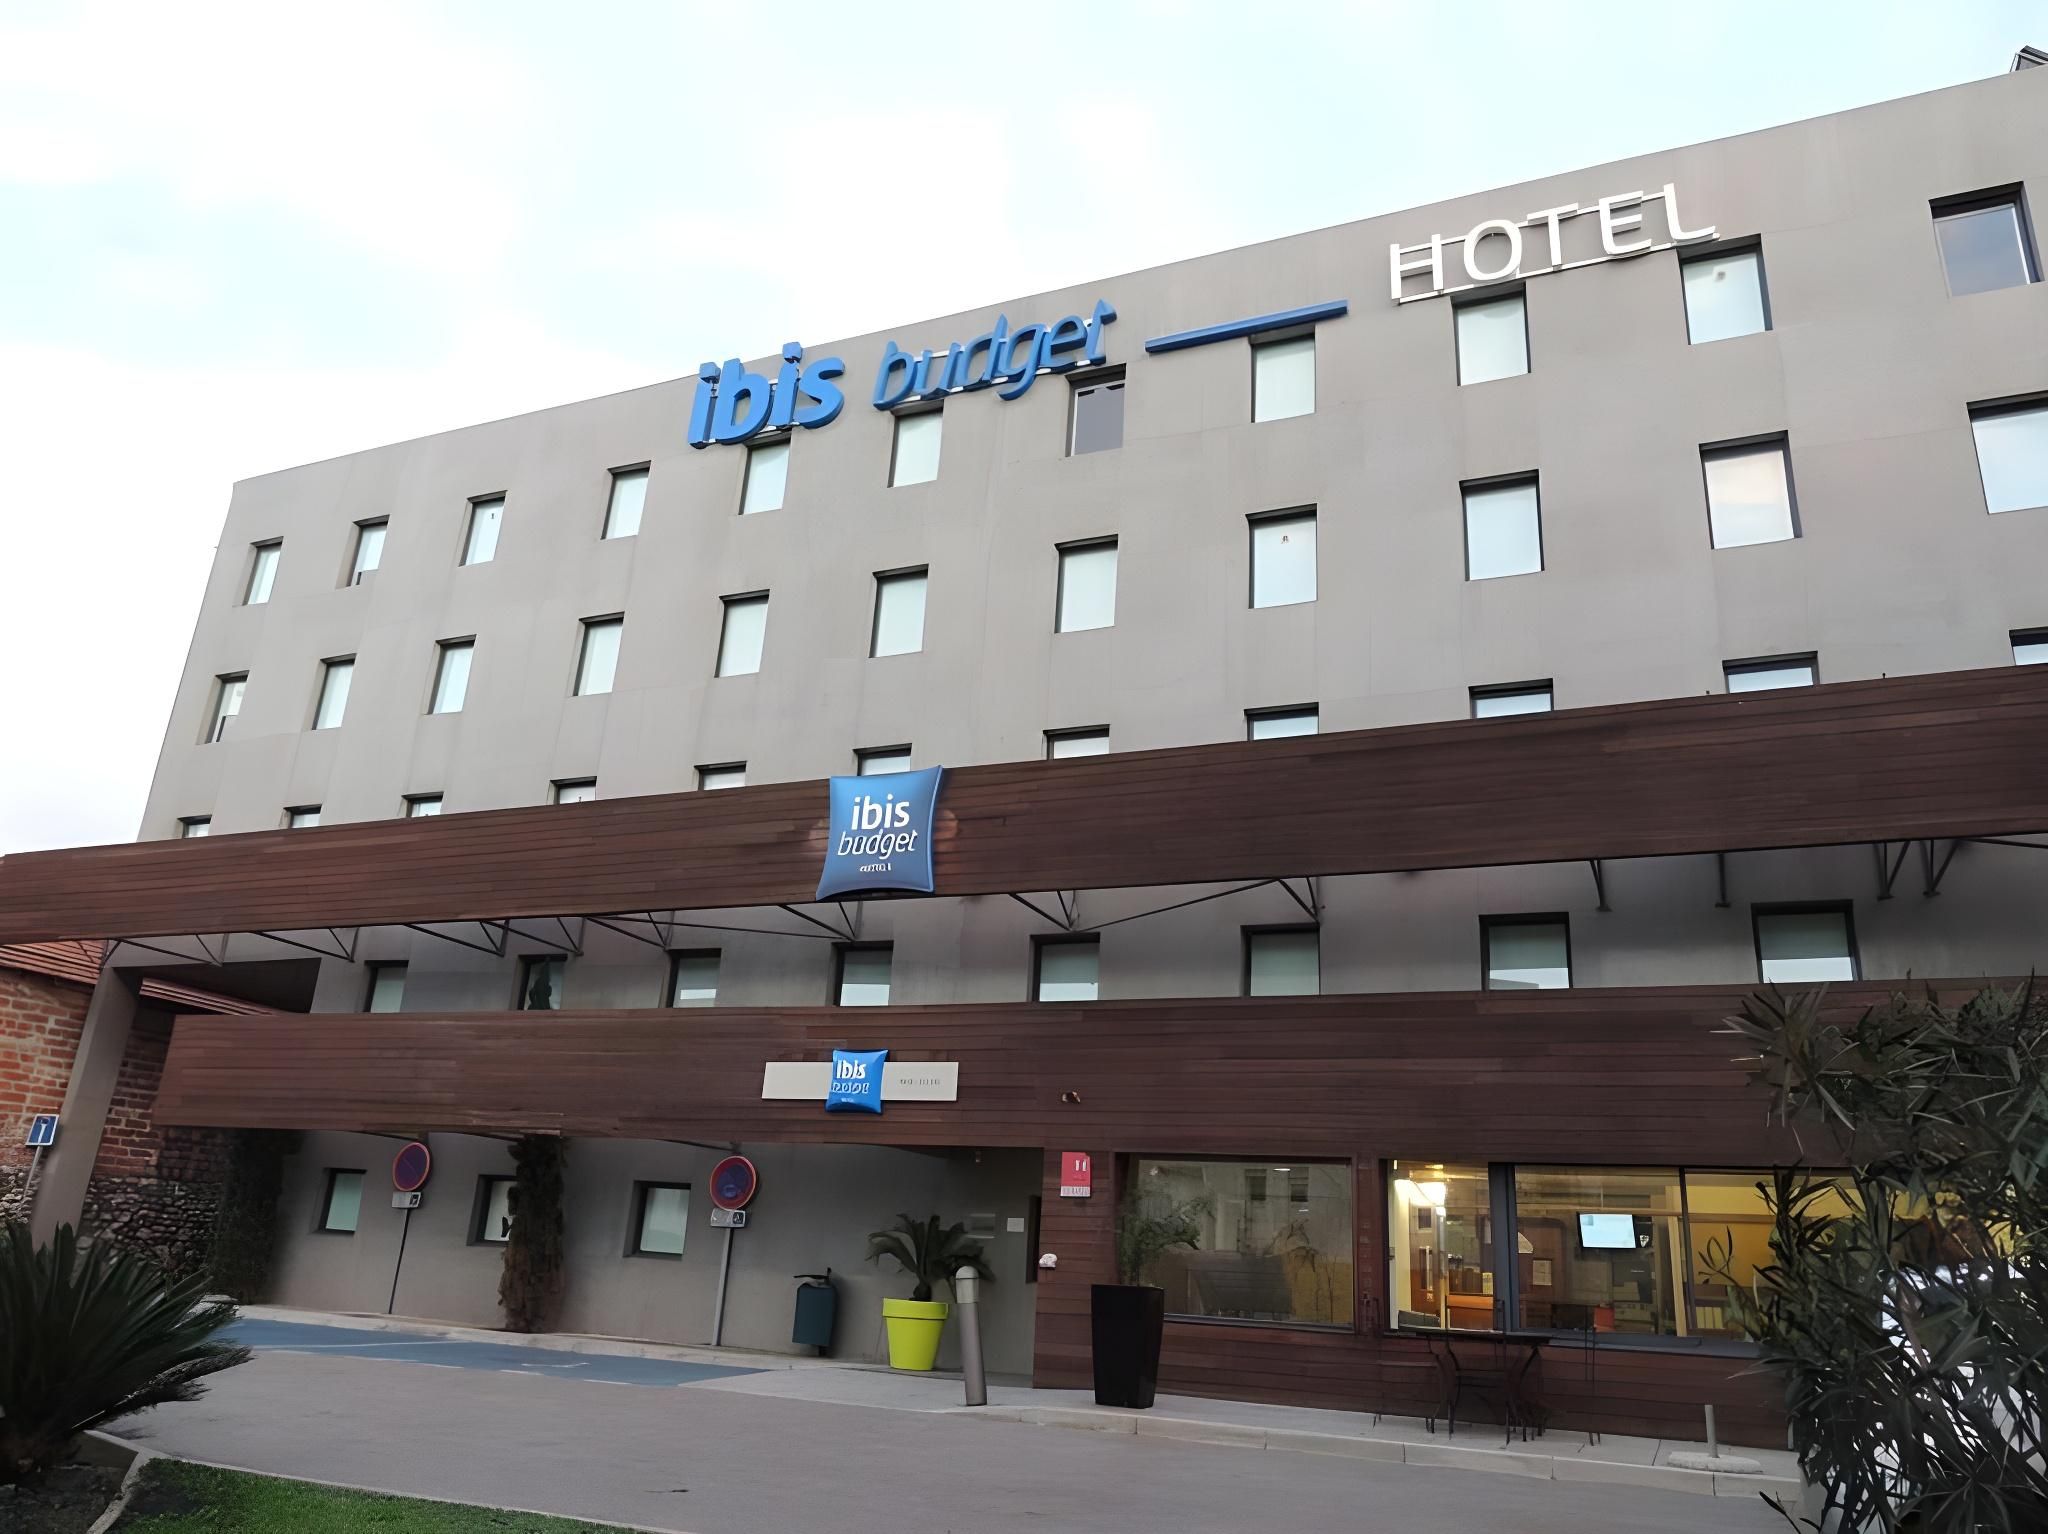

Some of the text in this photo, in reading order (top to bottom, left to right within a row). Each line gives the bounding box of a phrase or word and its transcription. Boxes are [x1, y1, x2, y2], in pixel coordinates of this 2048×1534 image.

[1390, 183, 1716, 300] HOTEL
[688, 298, 1118, 449] ibis budget
[837, 828, 918, 860] budget
[851, 793, 910, 830] ibis
